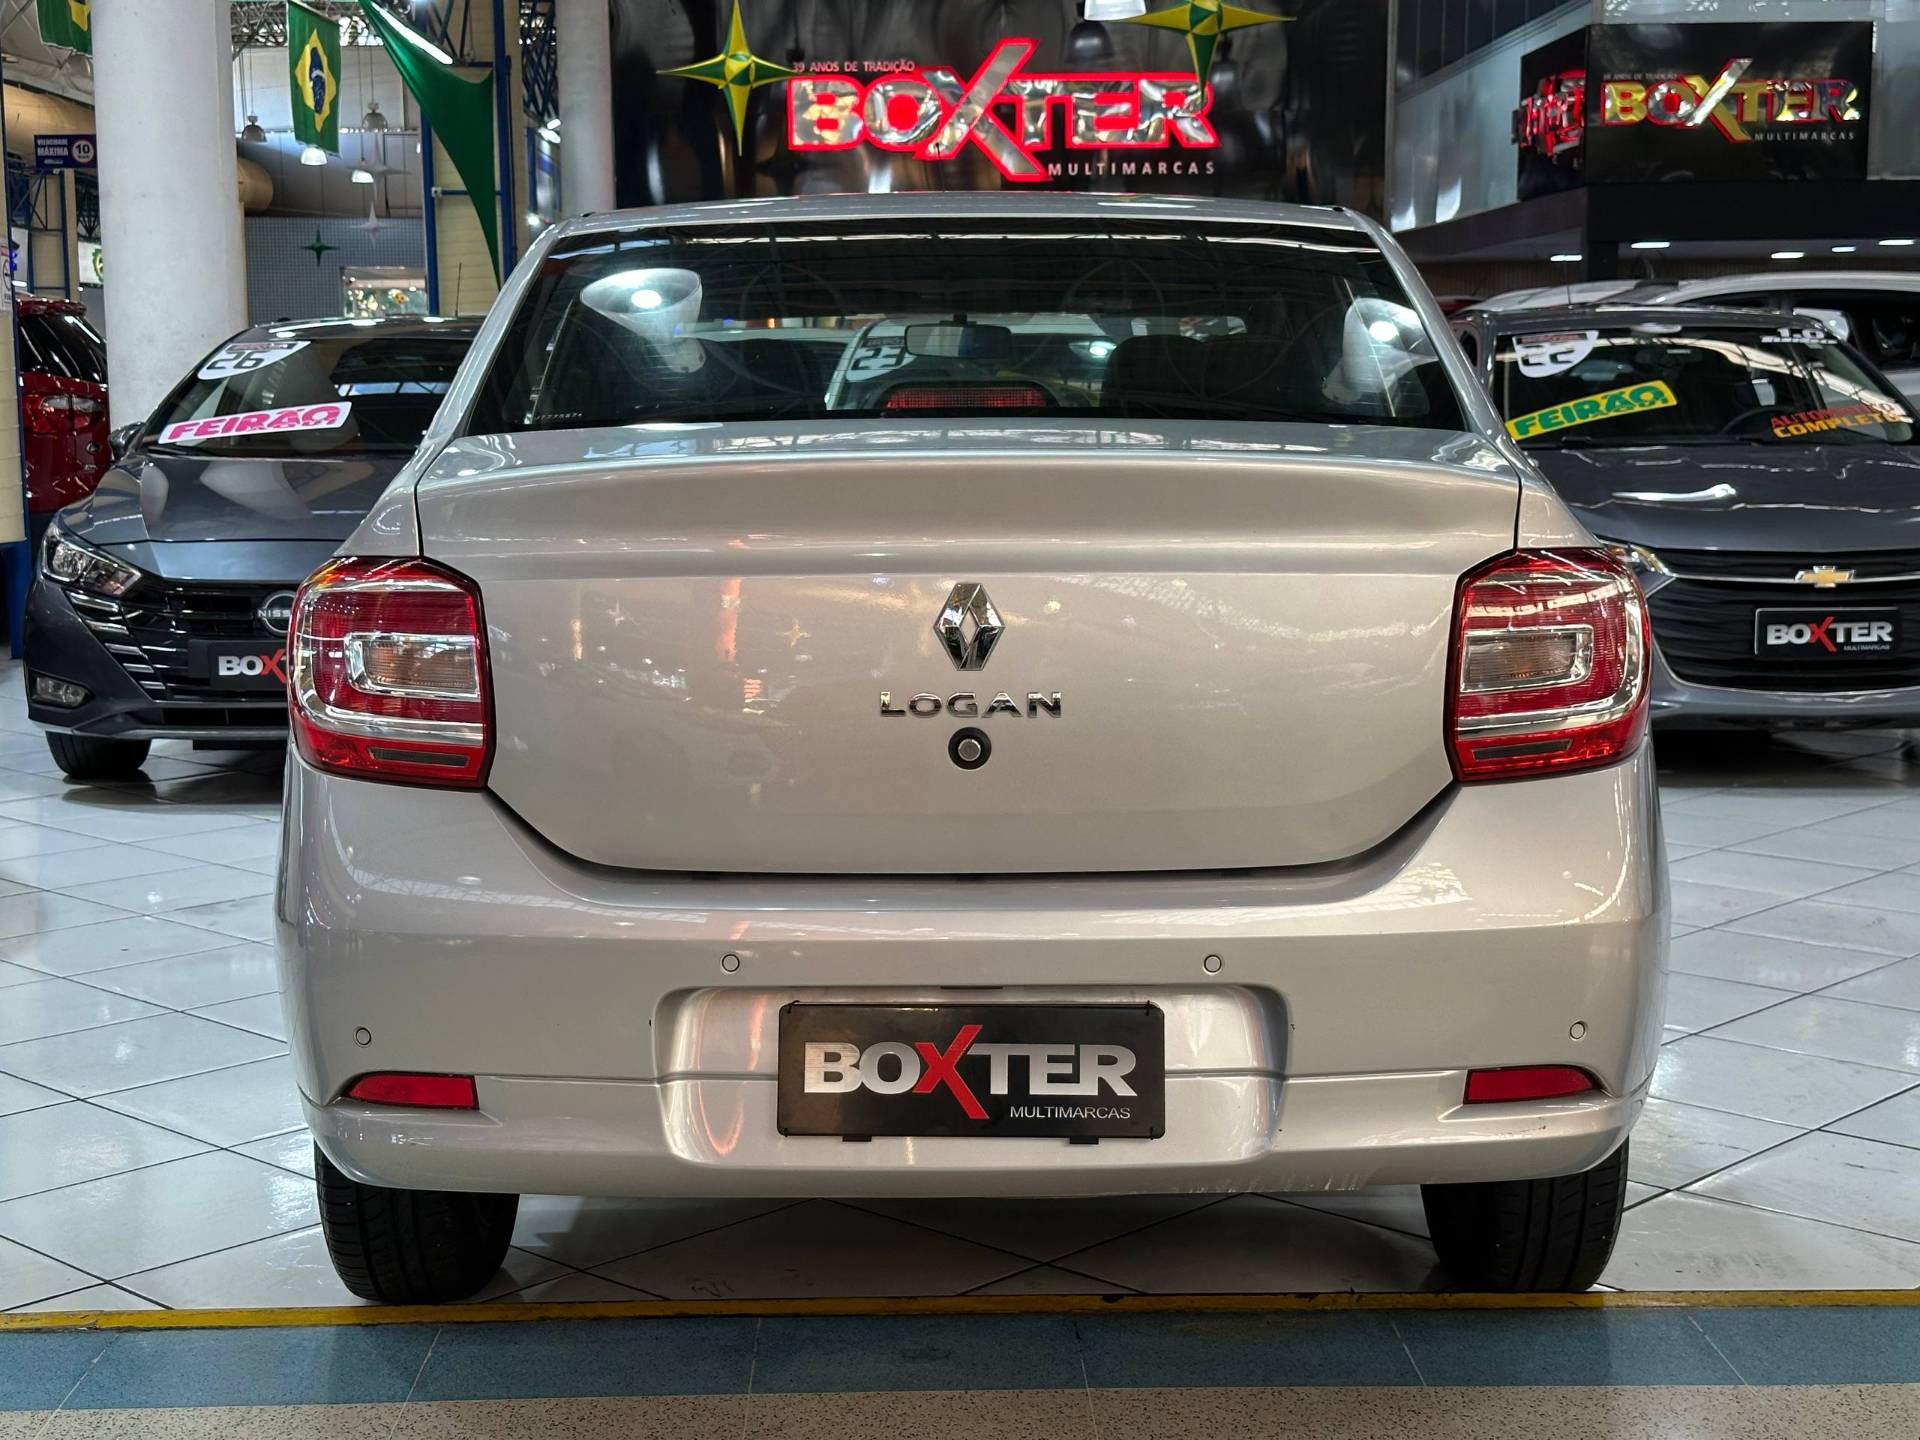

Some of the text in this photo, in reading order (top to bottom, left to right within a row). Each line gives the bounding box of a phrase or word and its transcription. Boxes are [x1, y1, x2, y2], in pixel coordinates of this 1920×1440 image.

[792, 58, 915, 74] 39 ANOS DE TRADIÇÃO
[787, 37, 1221, 182] BOXTER
[1600, 57, 1861, 143] BOXTER
[75, 144, 90, 154] 10
[1754, 131, 1855, 144] MULTIMARCAS
[37, 146, 69, 156] MÁXIMA
[1048, 161, 1215, 176] MULTIMARCAS
[206, 350, 265, 370] 26
[167, 405, 341, 440] FEIRÃO
[1514, 384, 1670, 437] FEIRÃO
[1773, 412, 1901, 438] COMPLETO
[1766, 615, 1893, 652] BOXTER
[1843, 643, 1891, 651] MULTIMARCAS
[218, 648, 287, 683] BOX
[879, 691, 1063, 719] LOGAN
[804, 1024, 1138, 1120] BOXTER
[1009, 1105, 1131, 1119] MULTIMARCAS
